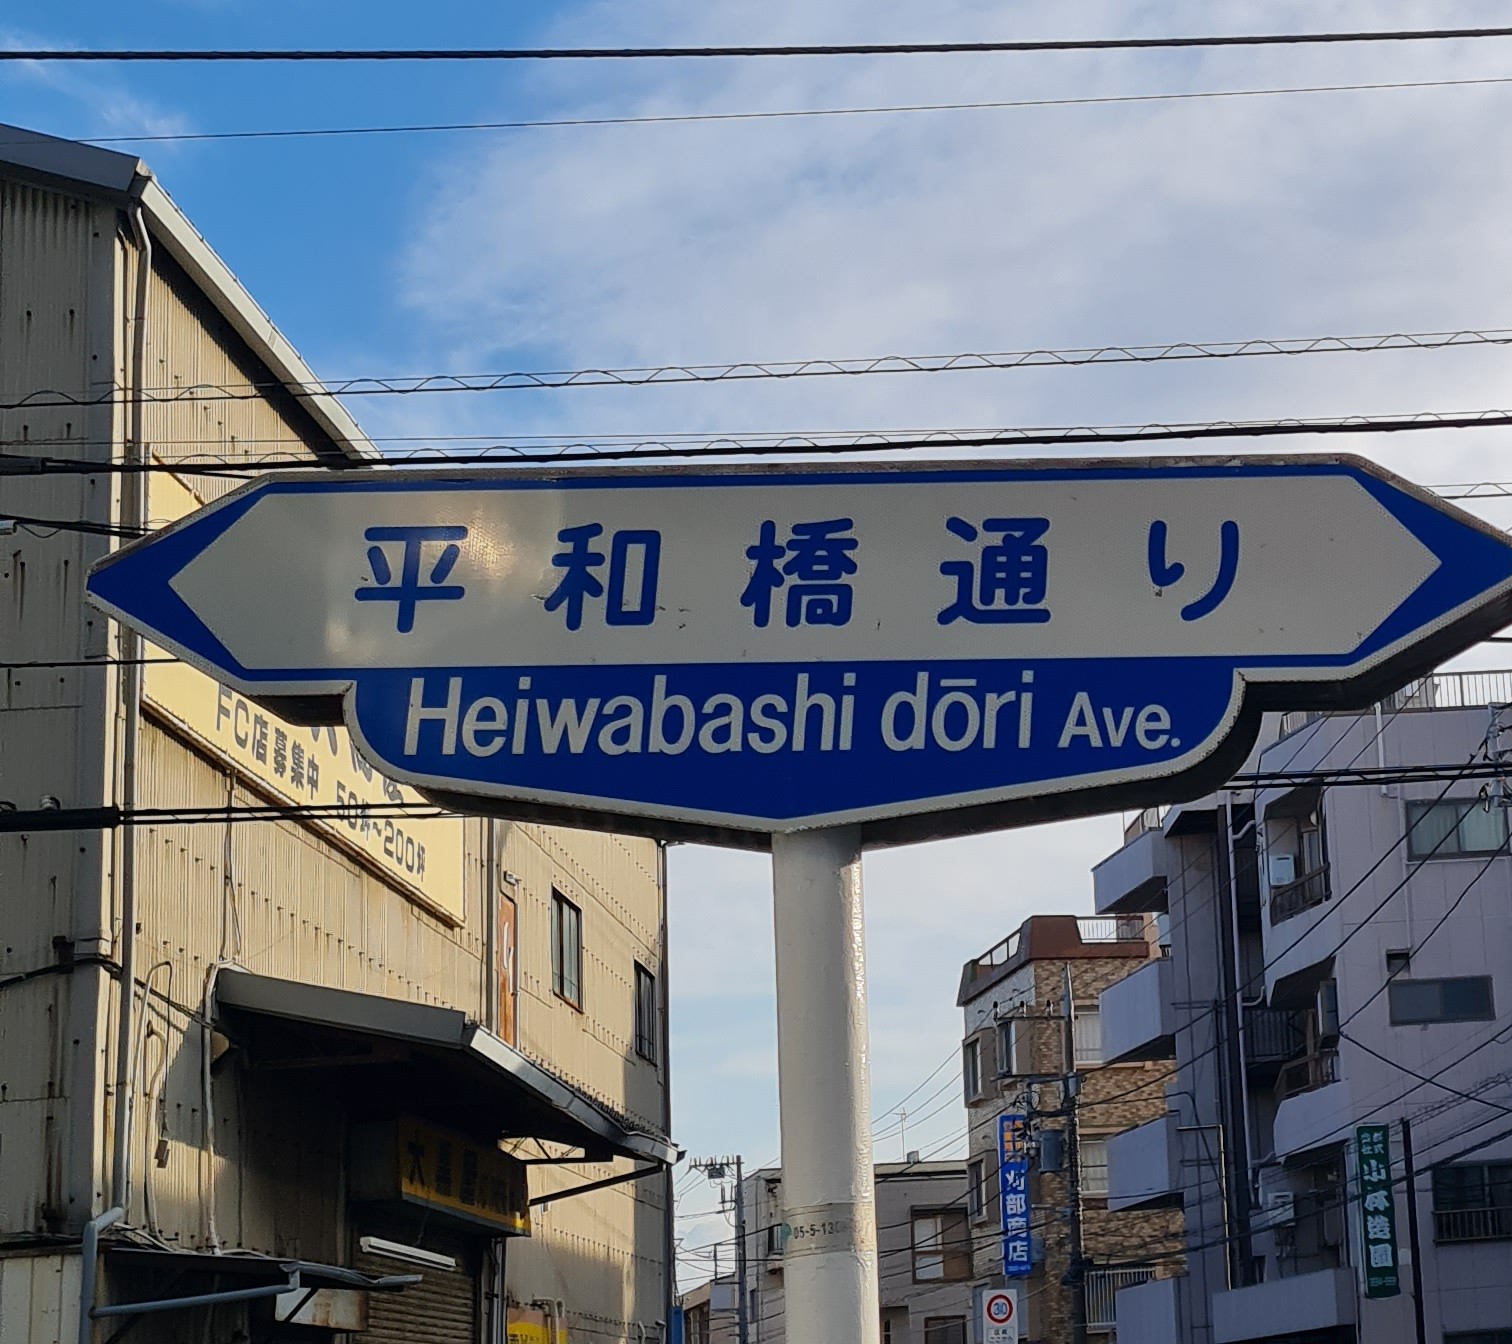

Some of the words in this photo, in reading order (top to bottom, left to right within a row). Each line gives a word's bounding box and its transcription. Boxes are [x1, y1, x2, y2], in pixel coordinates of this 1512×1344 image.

[355, 517, 1239, 633] 平和橋通り
[403, 672, 855, 757] Heiwabashi
[881, 669, 1034, 753] dōri
[1058, 692, 1181, 750] Ave.
[992, 1302, 1008, 1316] 30
